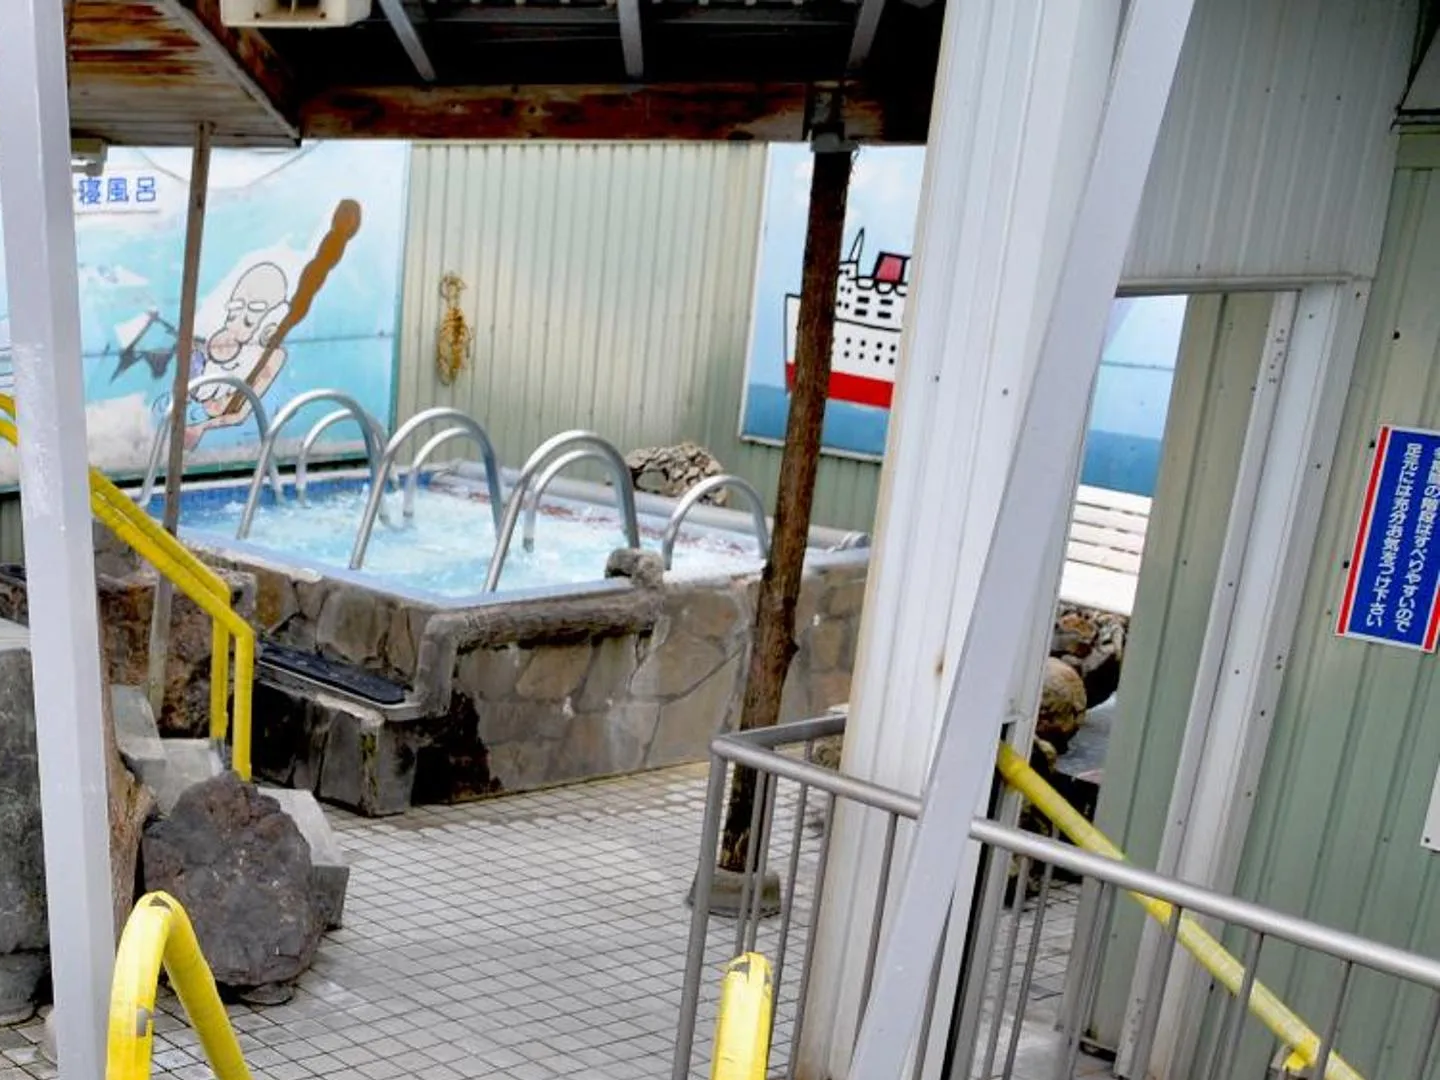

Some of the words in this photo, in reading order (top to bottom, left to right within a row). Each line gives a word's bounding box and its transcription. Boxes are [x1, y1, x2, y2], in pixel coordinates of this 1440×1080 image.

[78, 176, 157, 205] 寝風呂
[1395, 446, 1440, 633] の階段はすべりやすいので
